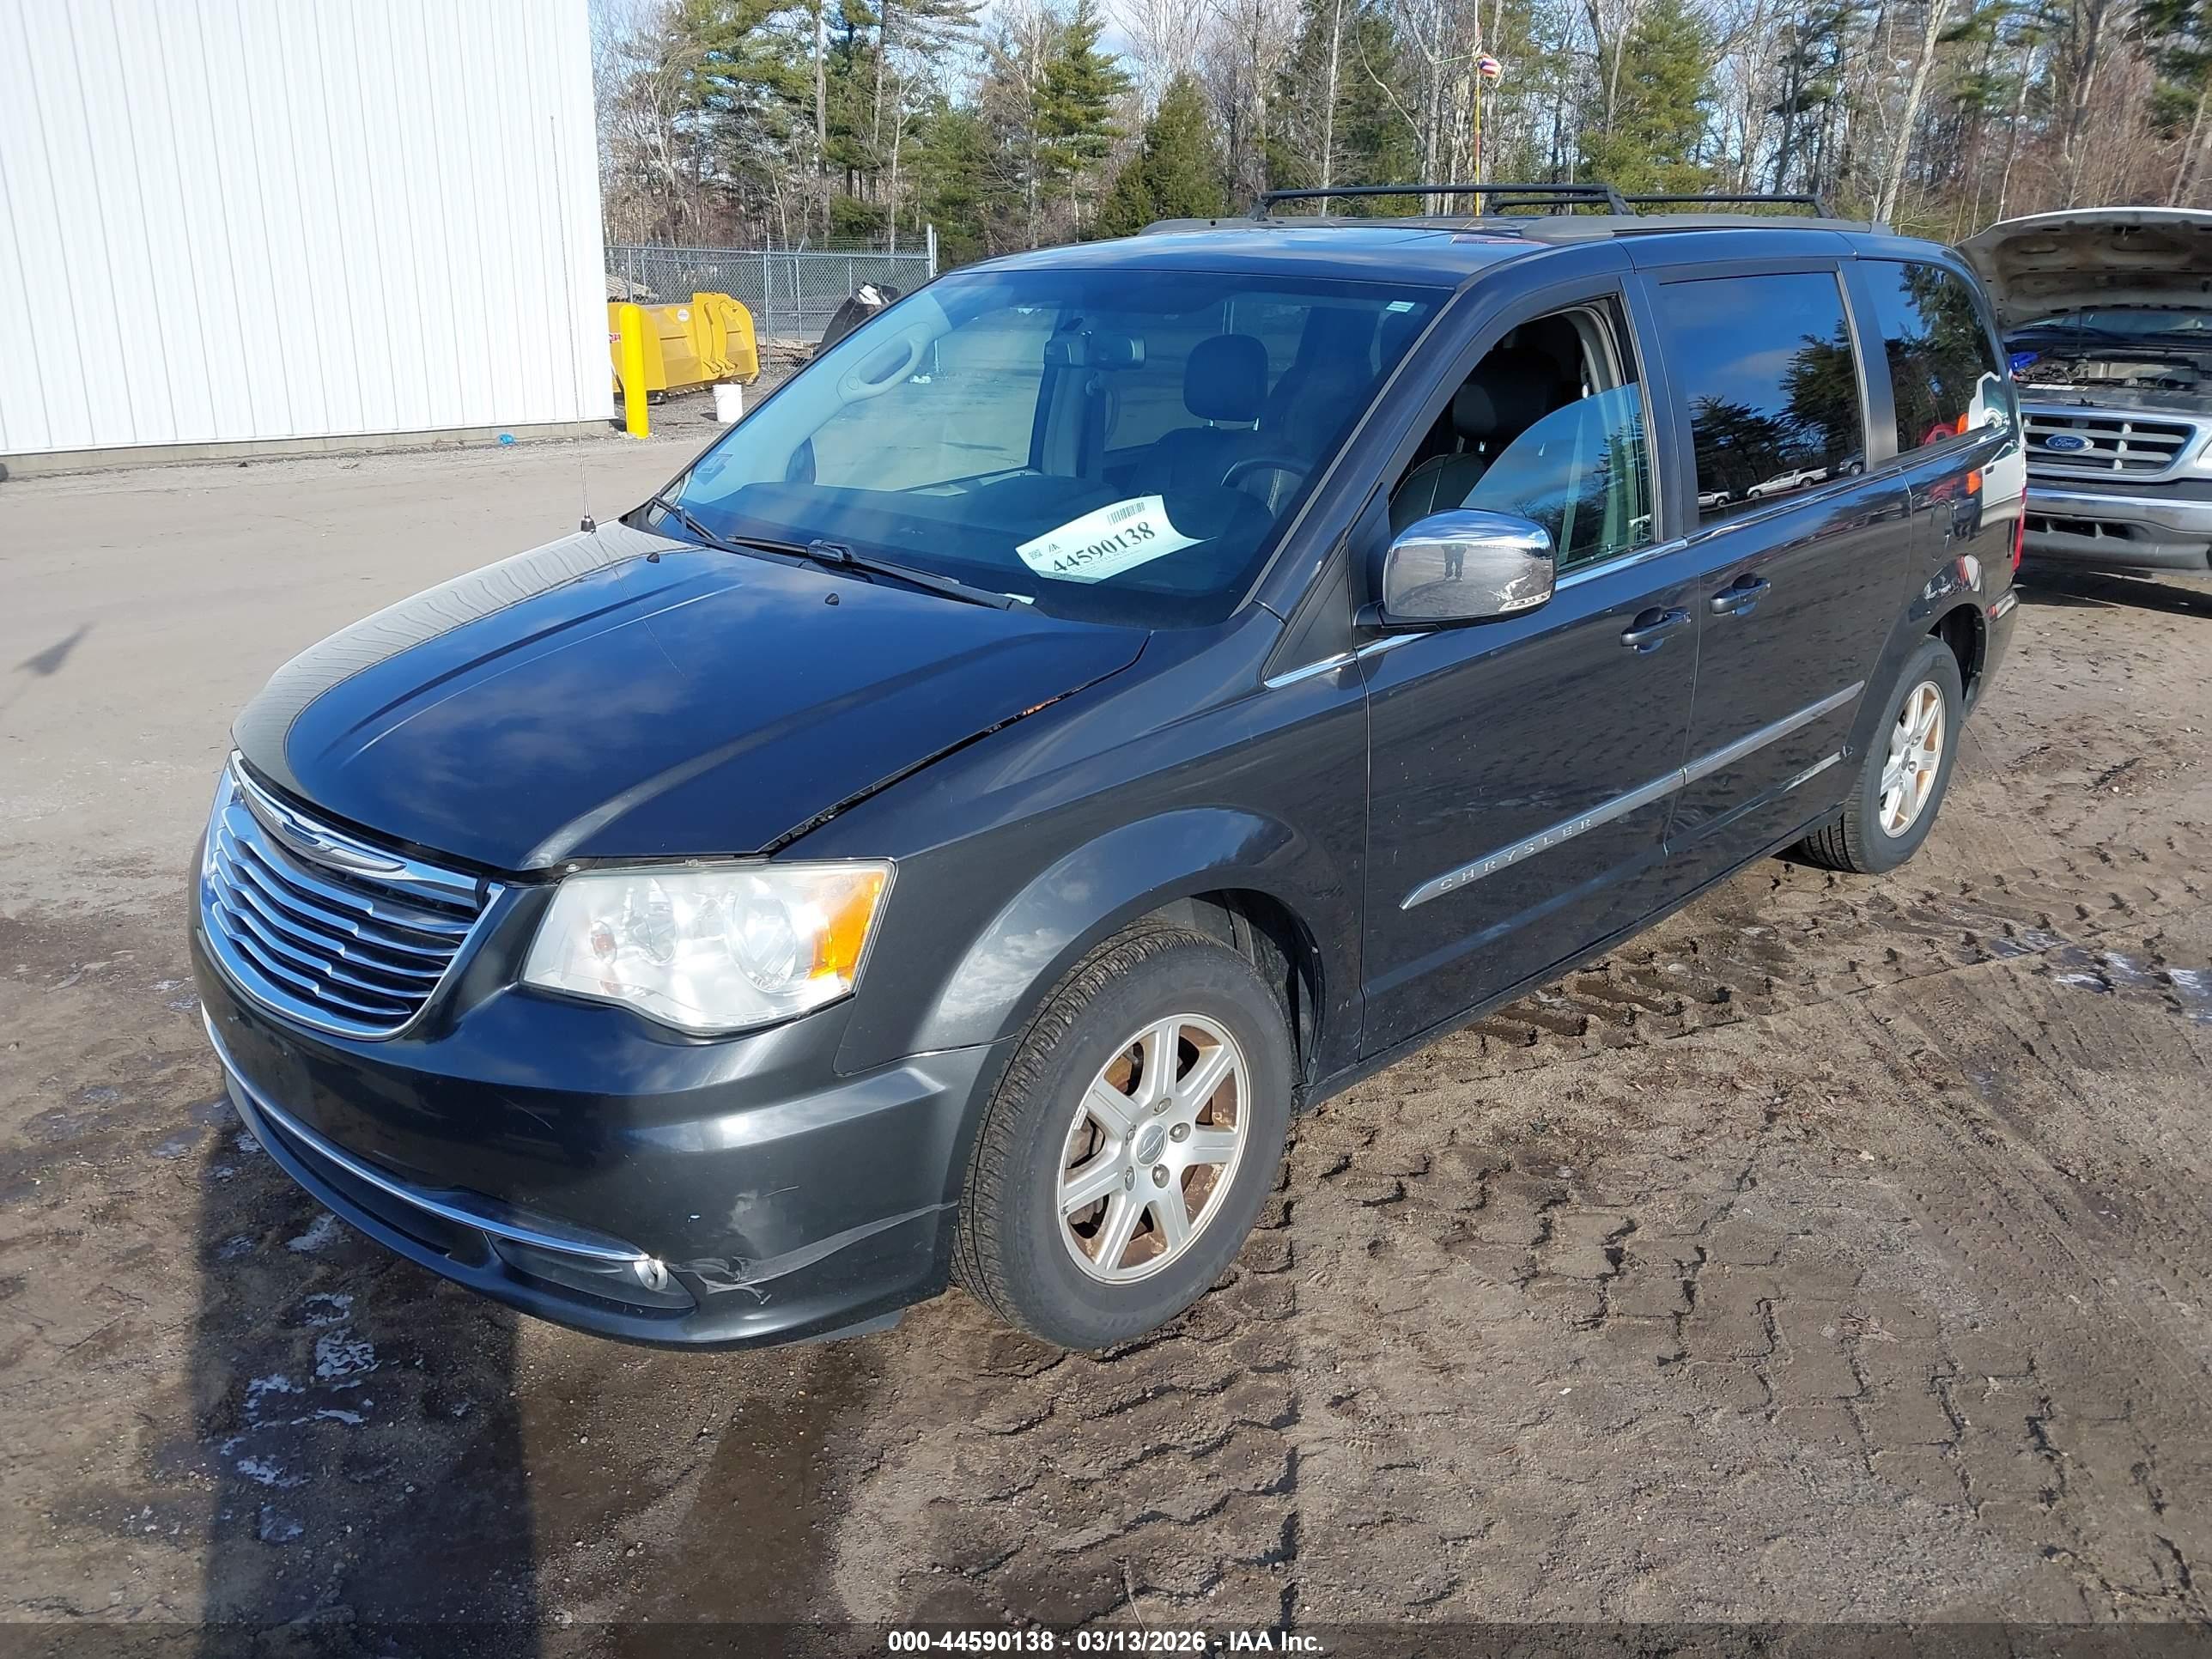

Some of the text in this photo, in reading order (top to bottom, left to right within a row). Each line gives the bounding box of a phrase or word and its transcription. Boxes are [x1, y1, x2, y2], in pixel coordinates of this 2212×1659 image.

[2054, 437, 2079, 447] Ford
[1054, 521, 1156, 572] 44590138
[1440, 818, 1591, 890] CHRYSLER
